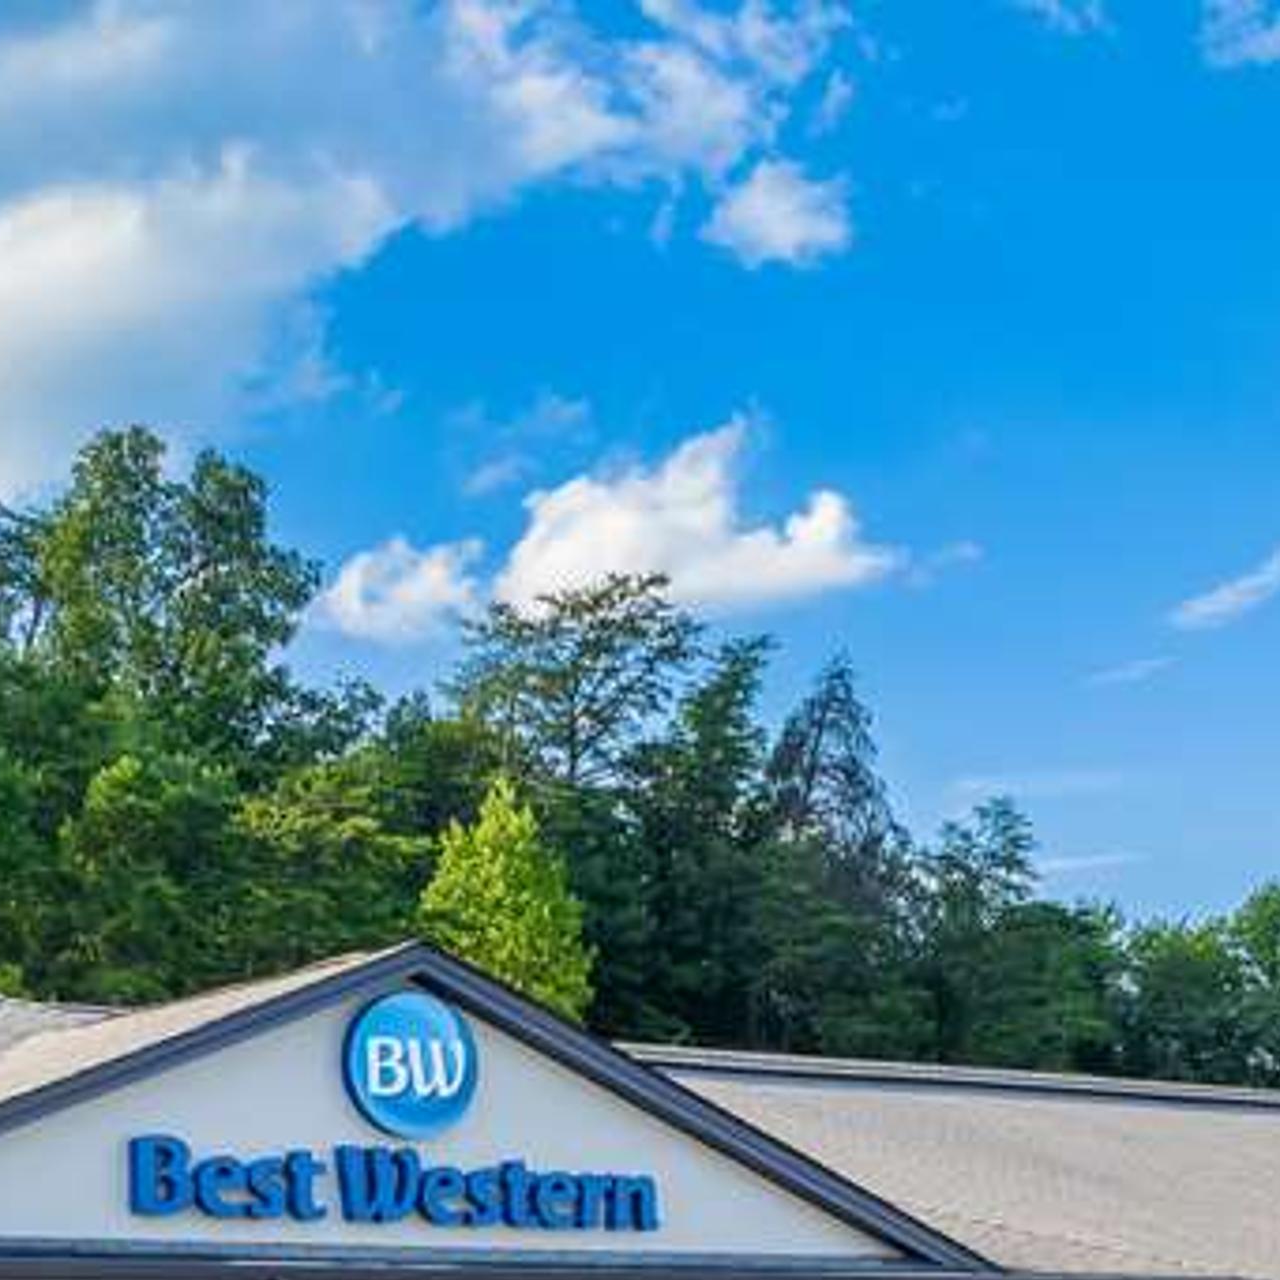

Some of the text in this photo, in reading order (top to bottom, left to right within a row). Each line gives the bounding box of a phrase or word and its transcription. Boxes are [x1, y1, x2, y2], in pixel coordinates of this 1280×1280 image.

[367, 1035, 465, 1099] BW
[129, 1134, 658, 1232] Best Western
